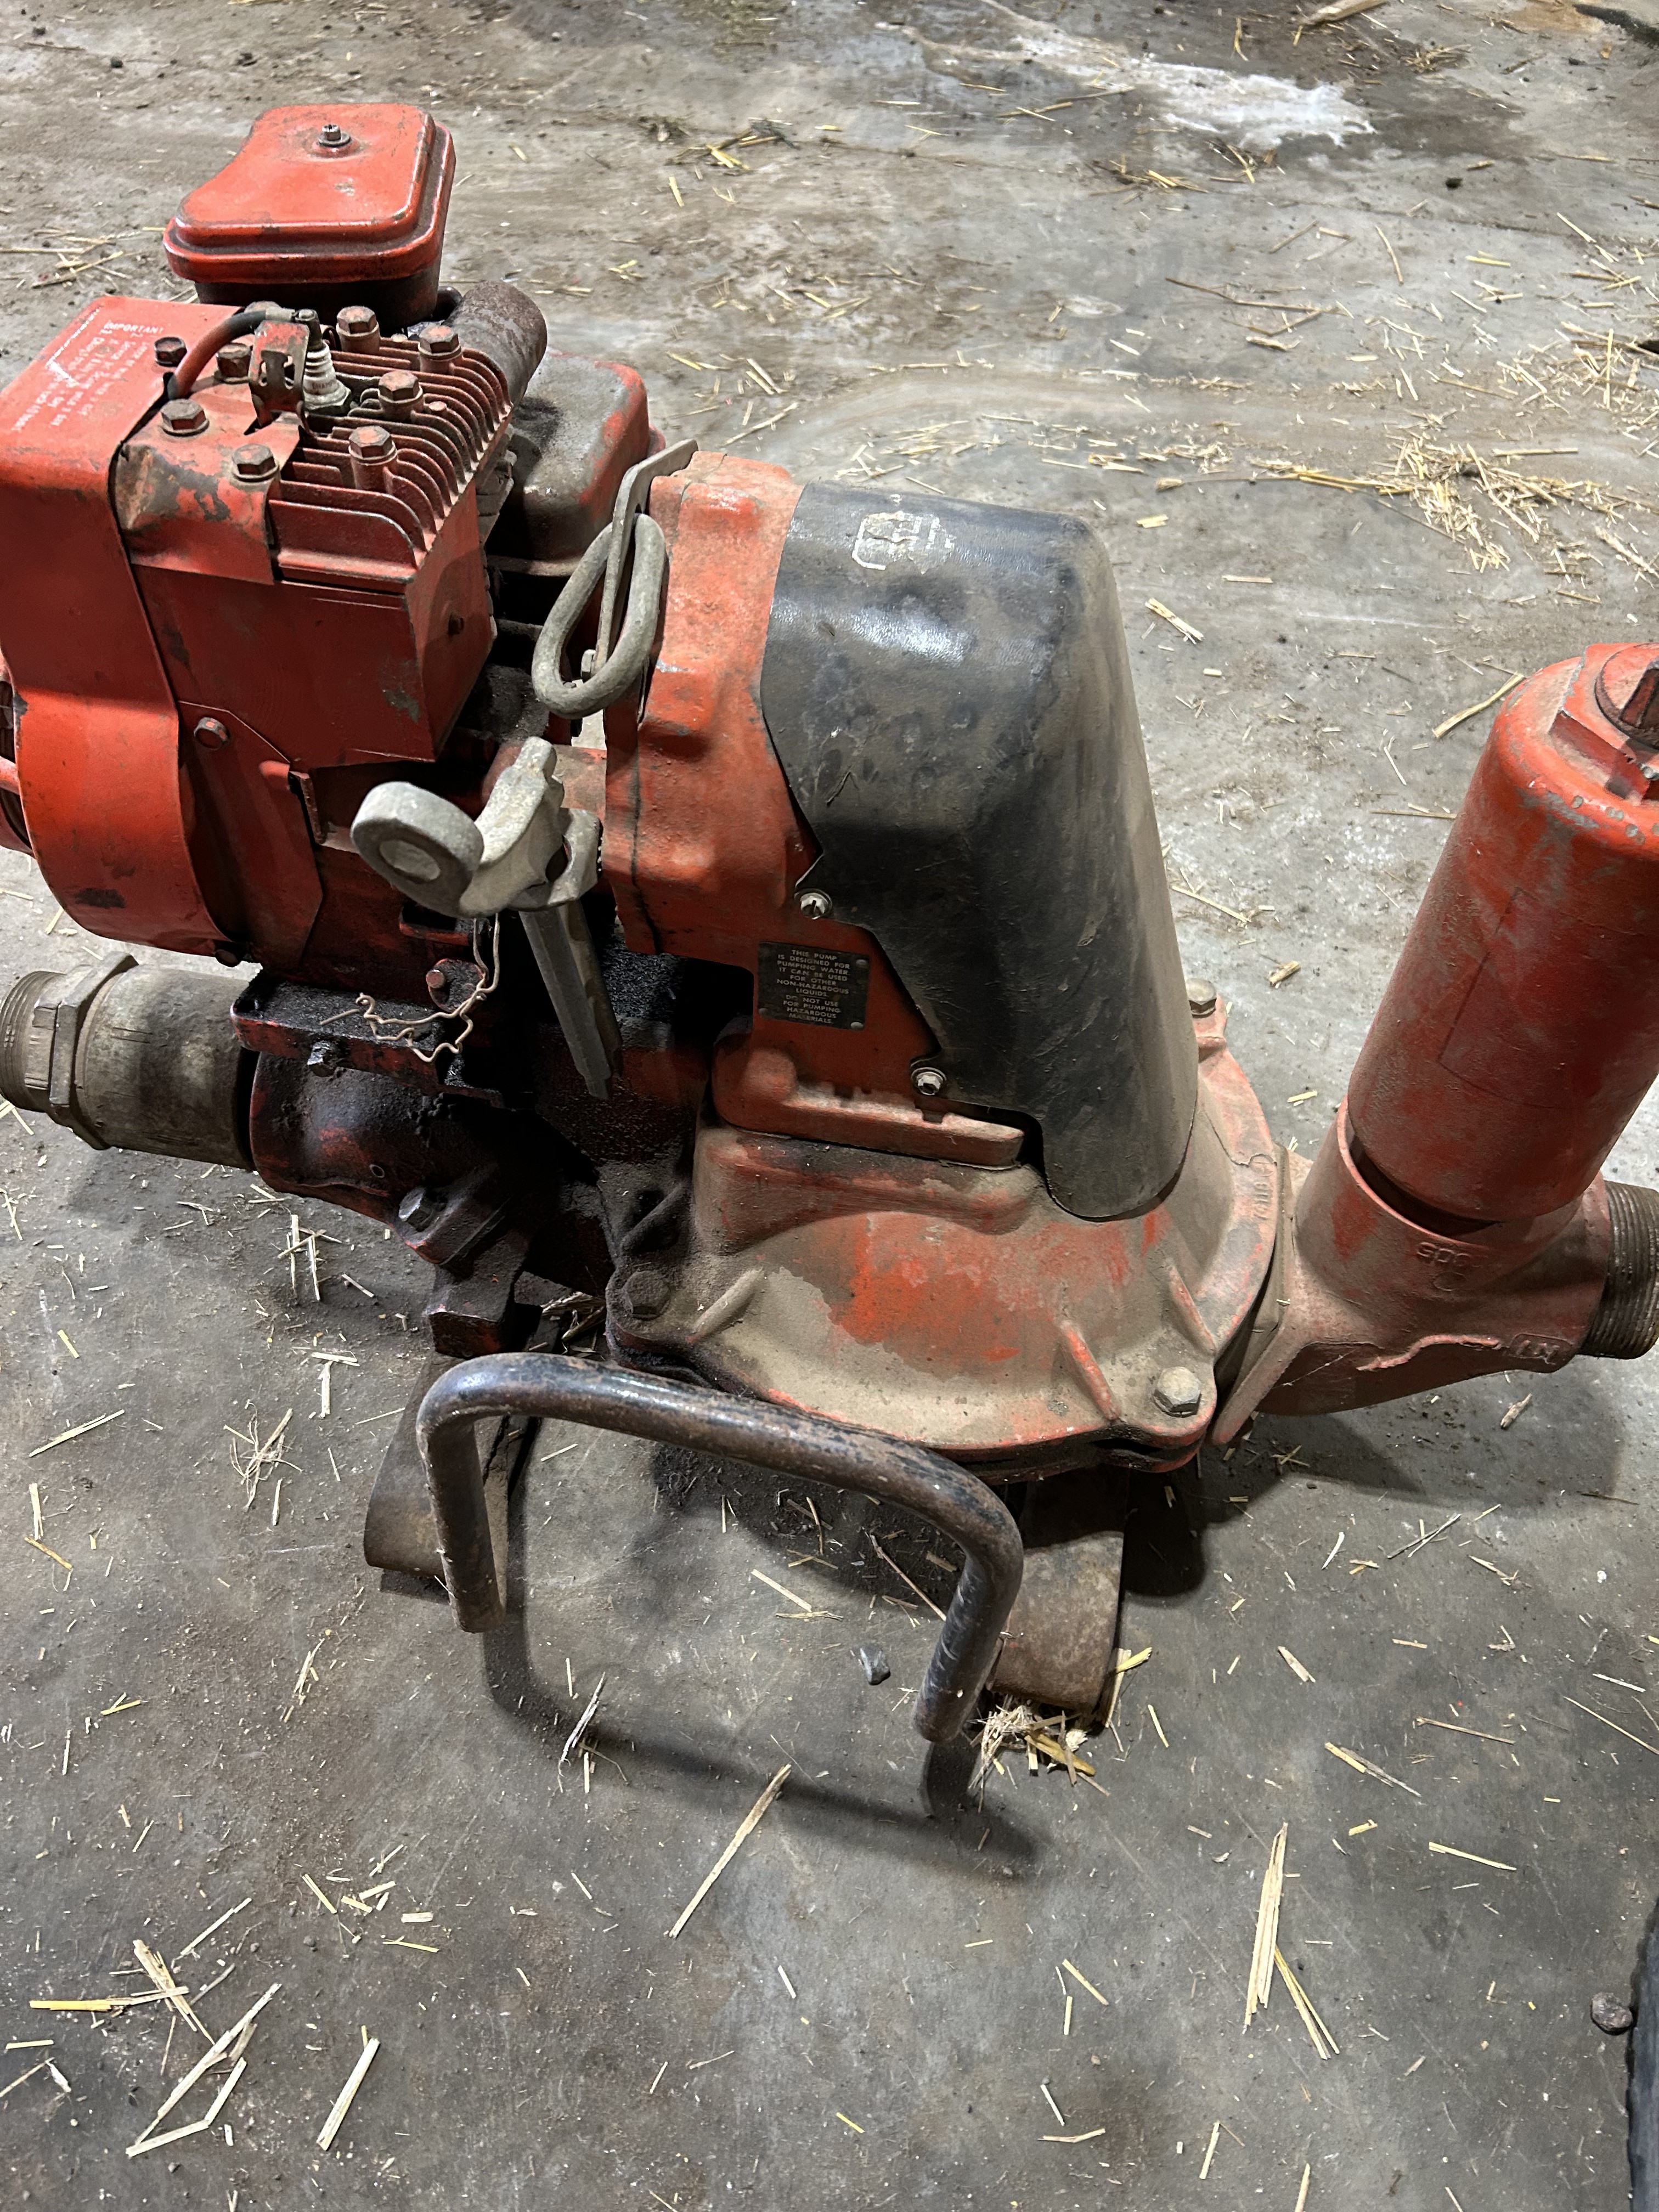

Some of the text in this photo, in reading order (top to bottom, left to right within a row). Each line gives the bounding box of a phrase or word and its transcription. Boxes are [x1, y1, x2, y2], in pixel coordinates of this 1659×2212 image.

[777, 961, 816, 970] PUMPING
[790, 956, 830, 966] DESIGNED
[777, 979, 849, 994] NON-HAZARDOUS
[787, 1007, 836, 1018] HAZARDOUS
[803, 1003, 841, 1013] PUMPING
